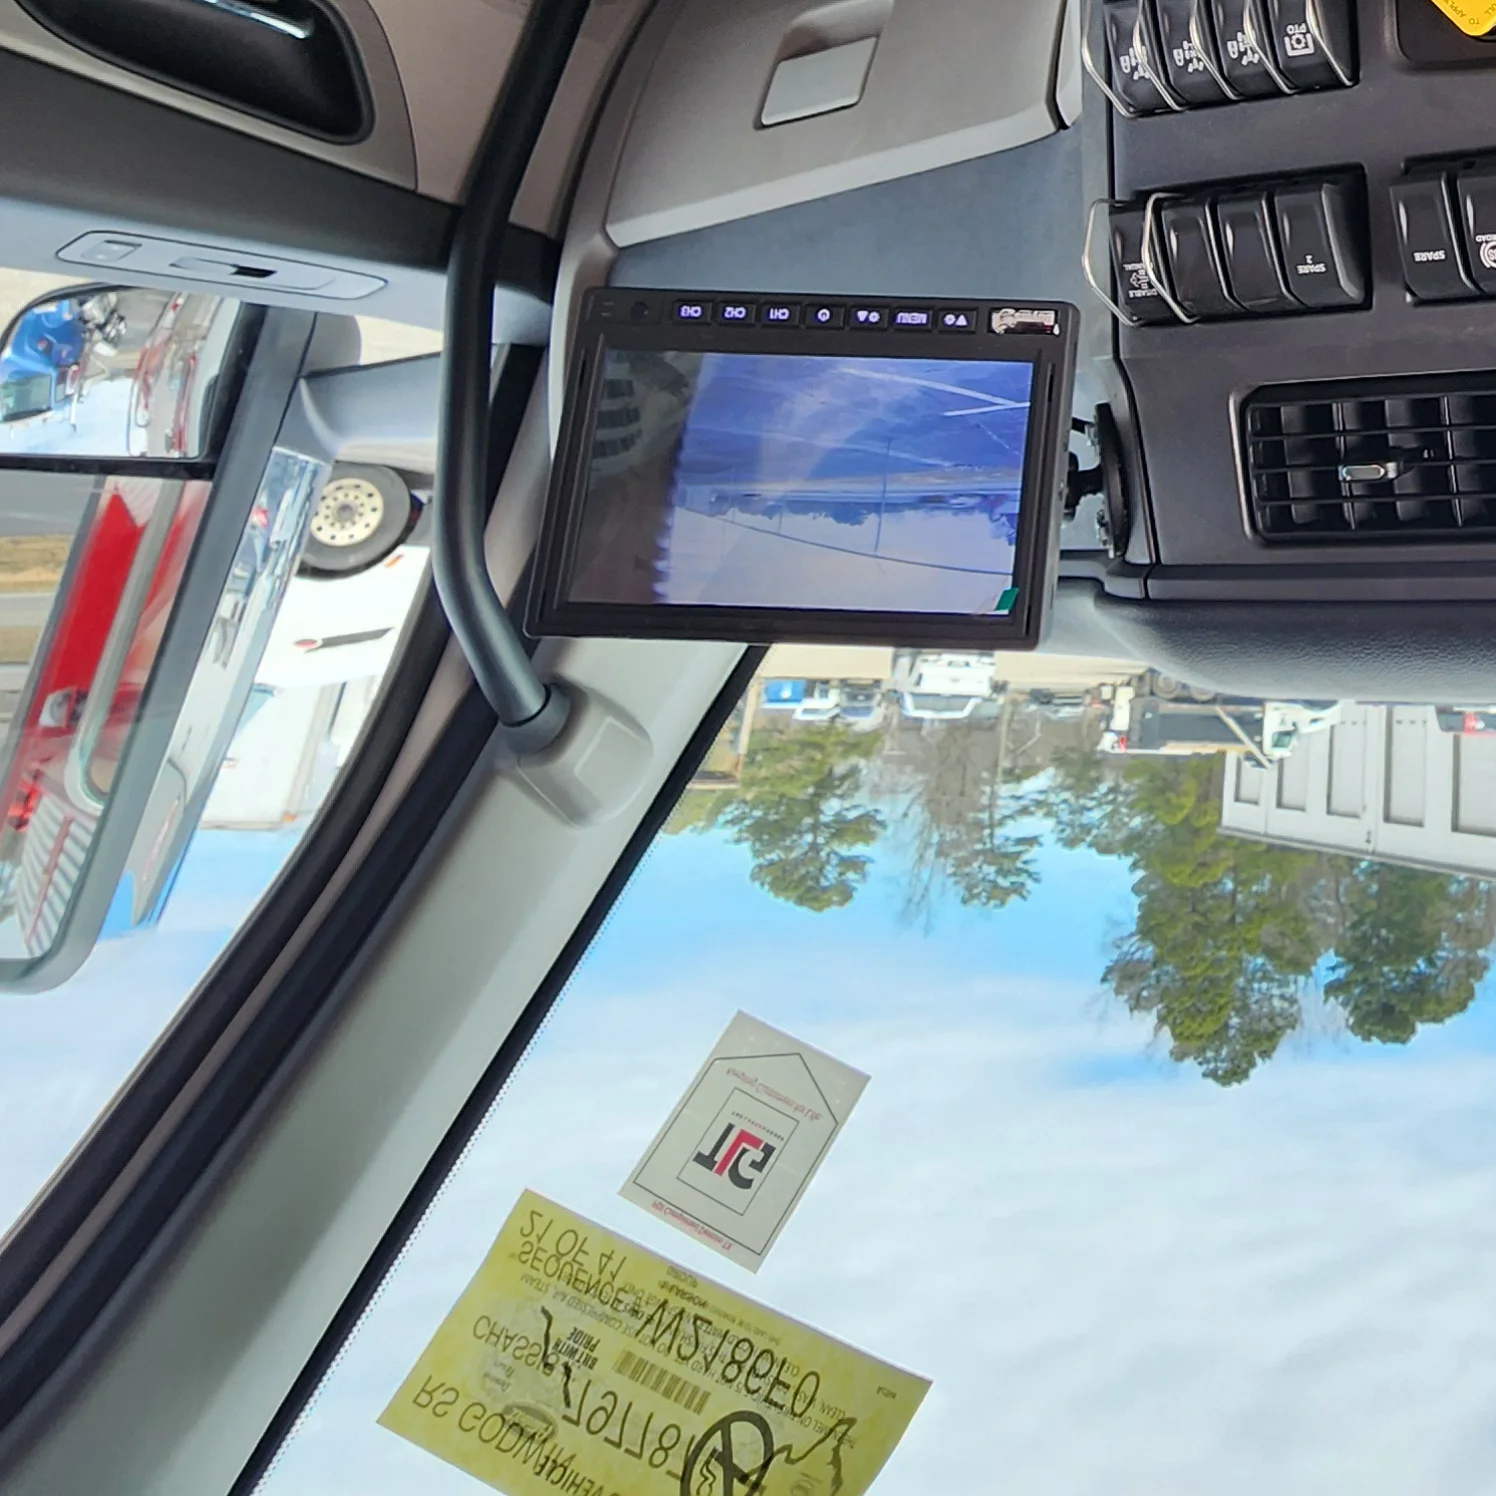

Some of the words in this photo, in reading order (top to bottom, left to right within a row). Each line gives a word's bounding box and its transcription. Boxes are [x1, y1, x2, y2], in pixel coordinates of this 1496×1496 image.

[1286, 23, 1306, 34] PTO
[1476, 234, 1496, 242] ROAD
[1305, 254, 1313, 264] 2
[1414, 250, 1446, 262] SPARE
[1297, 263, 1326, 274] SPARE
[680, 306, 702, 317] CH3
[724, 306, 746, 318] CH2
[769, 308, 789, 320] CH1
[895, 312, 927, 324] MENU
[519, 1272, 551, 1295] STEAM
[566, 1327, 601, 1354] PRIDE
